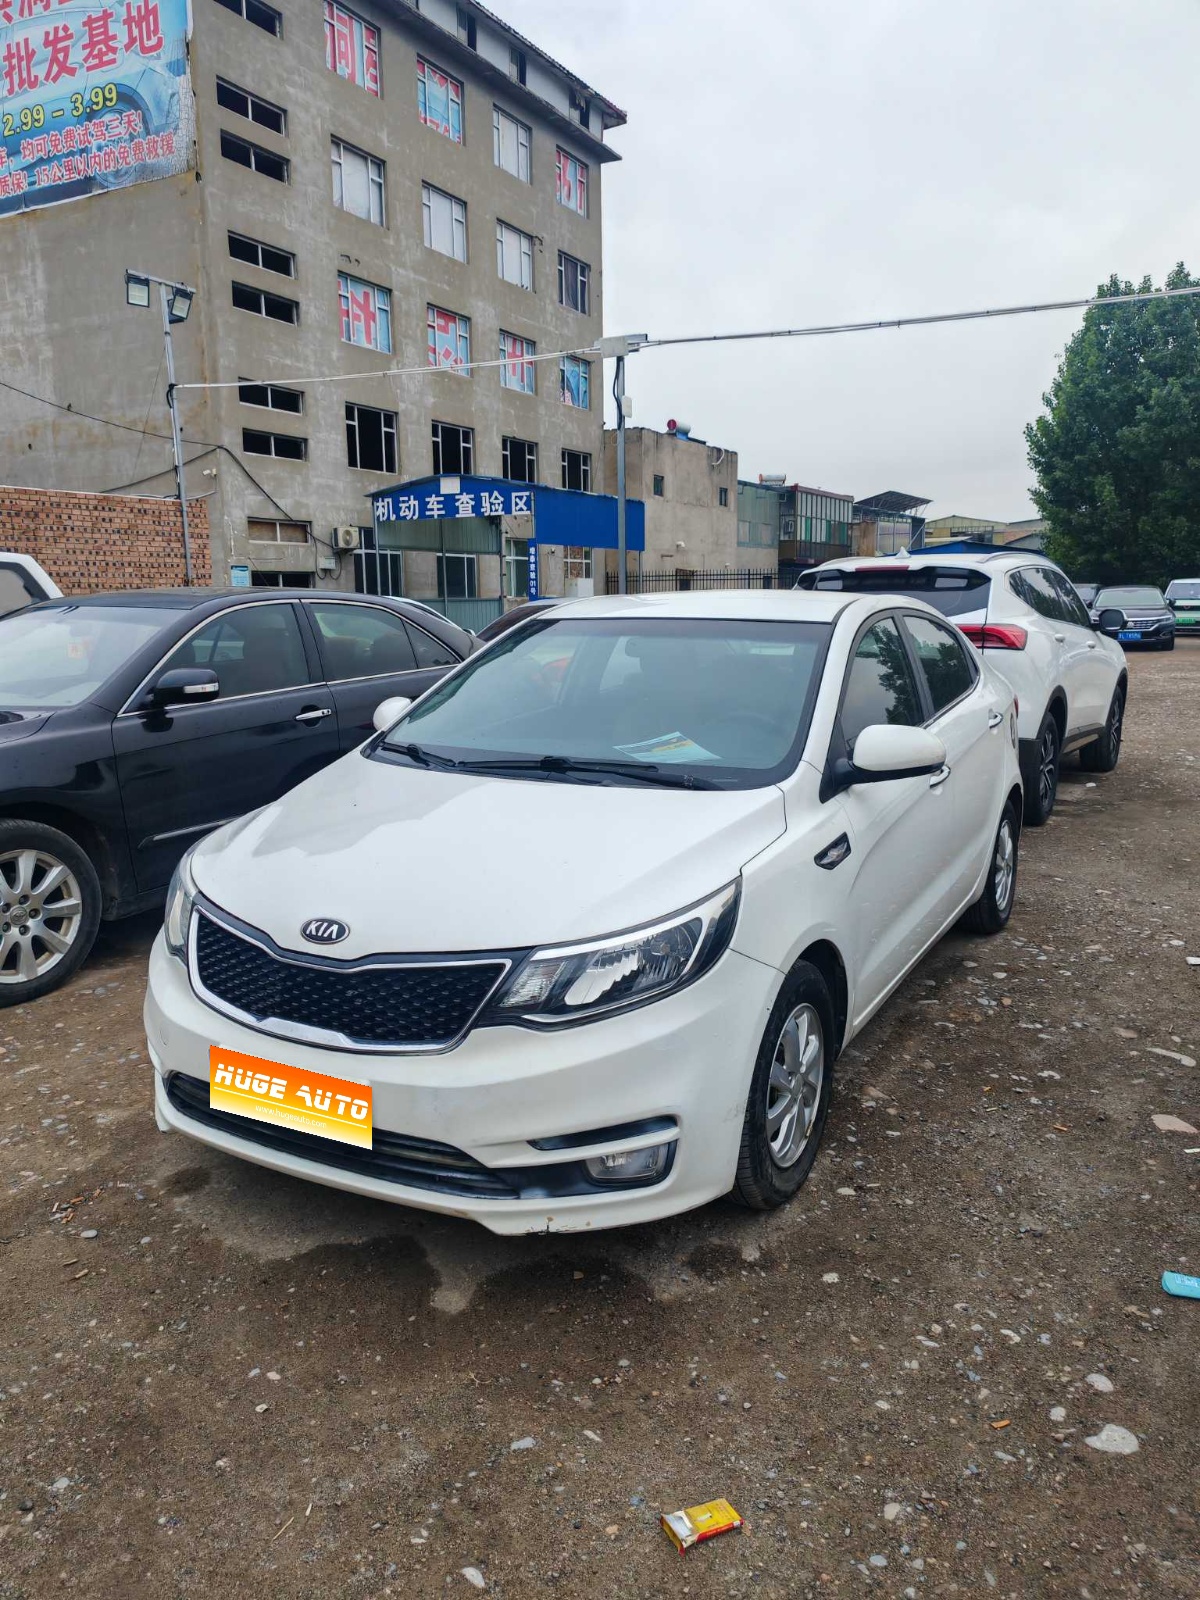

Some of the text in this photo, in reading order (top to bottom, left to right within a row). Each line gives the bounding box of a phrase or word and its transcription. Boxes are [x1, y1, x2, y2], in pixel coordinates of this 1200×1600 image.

[3, 1, 163, 95] 批发基地
[3, 105, 45, 137] 2.99
[70, 83, 118, 117] 3.99
[376, 491, 531, 522] 机动车查验区
[306, 921, 339, 939] KIA
